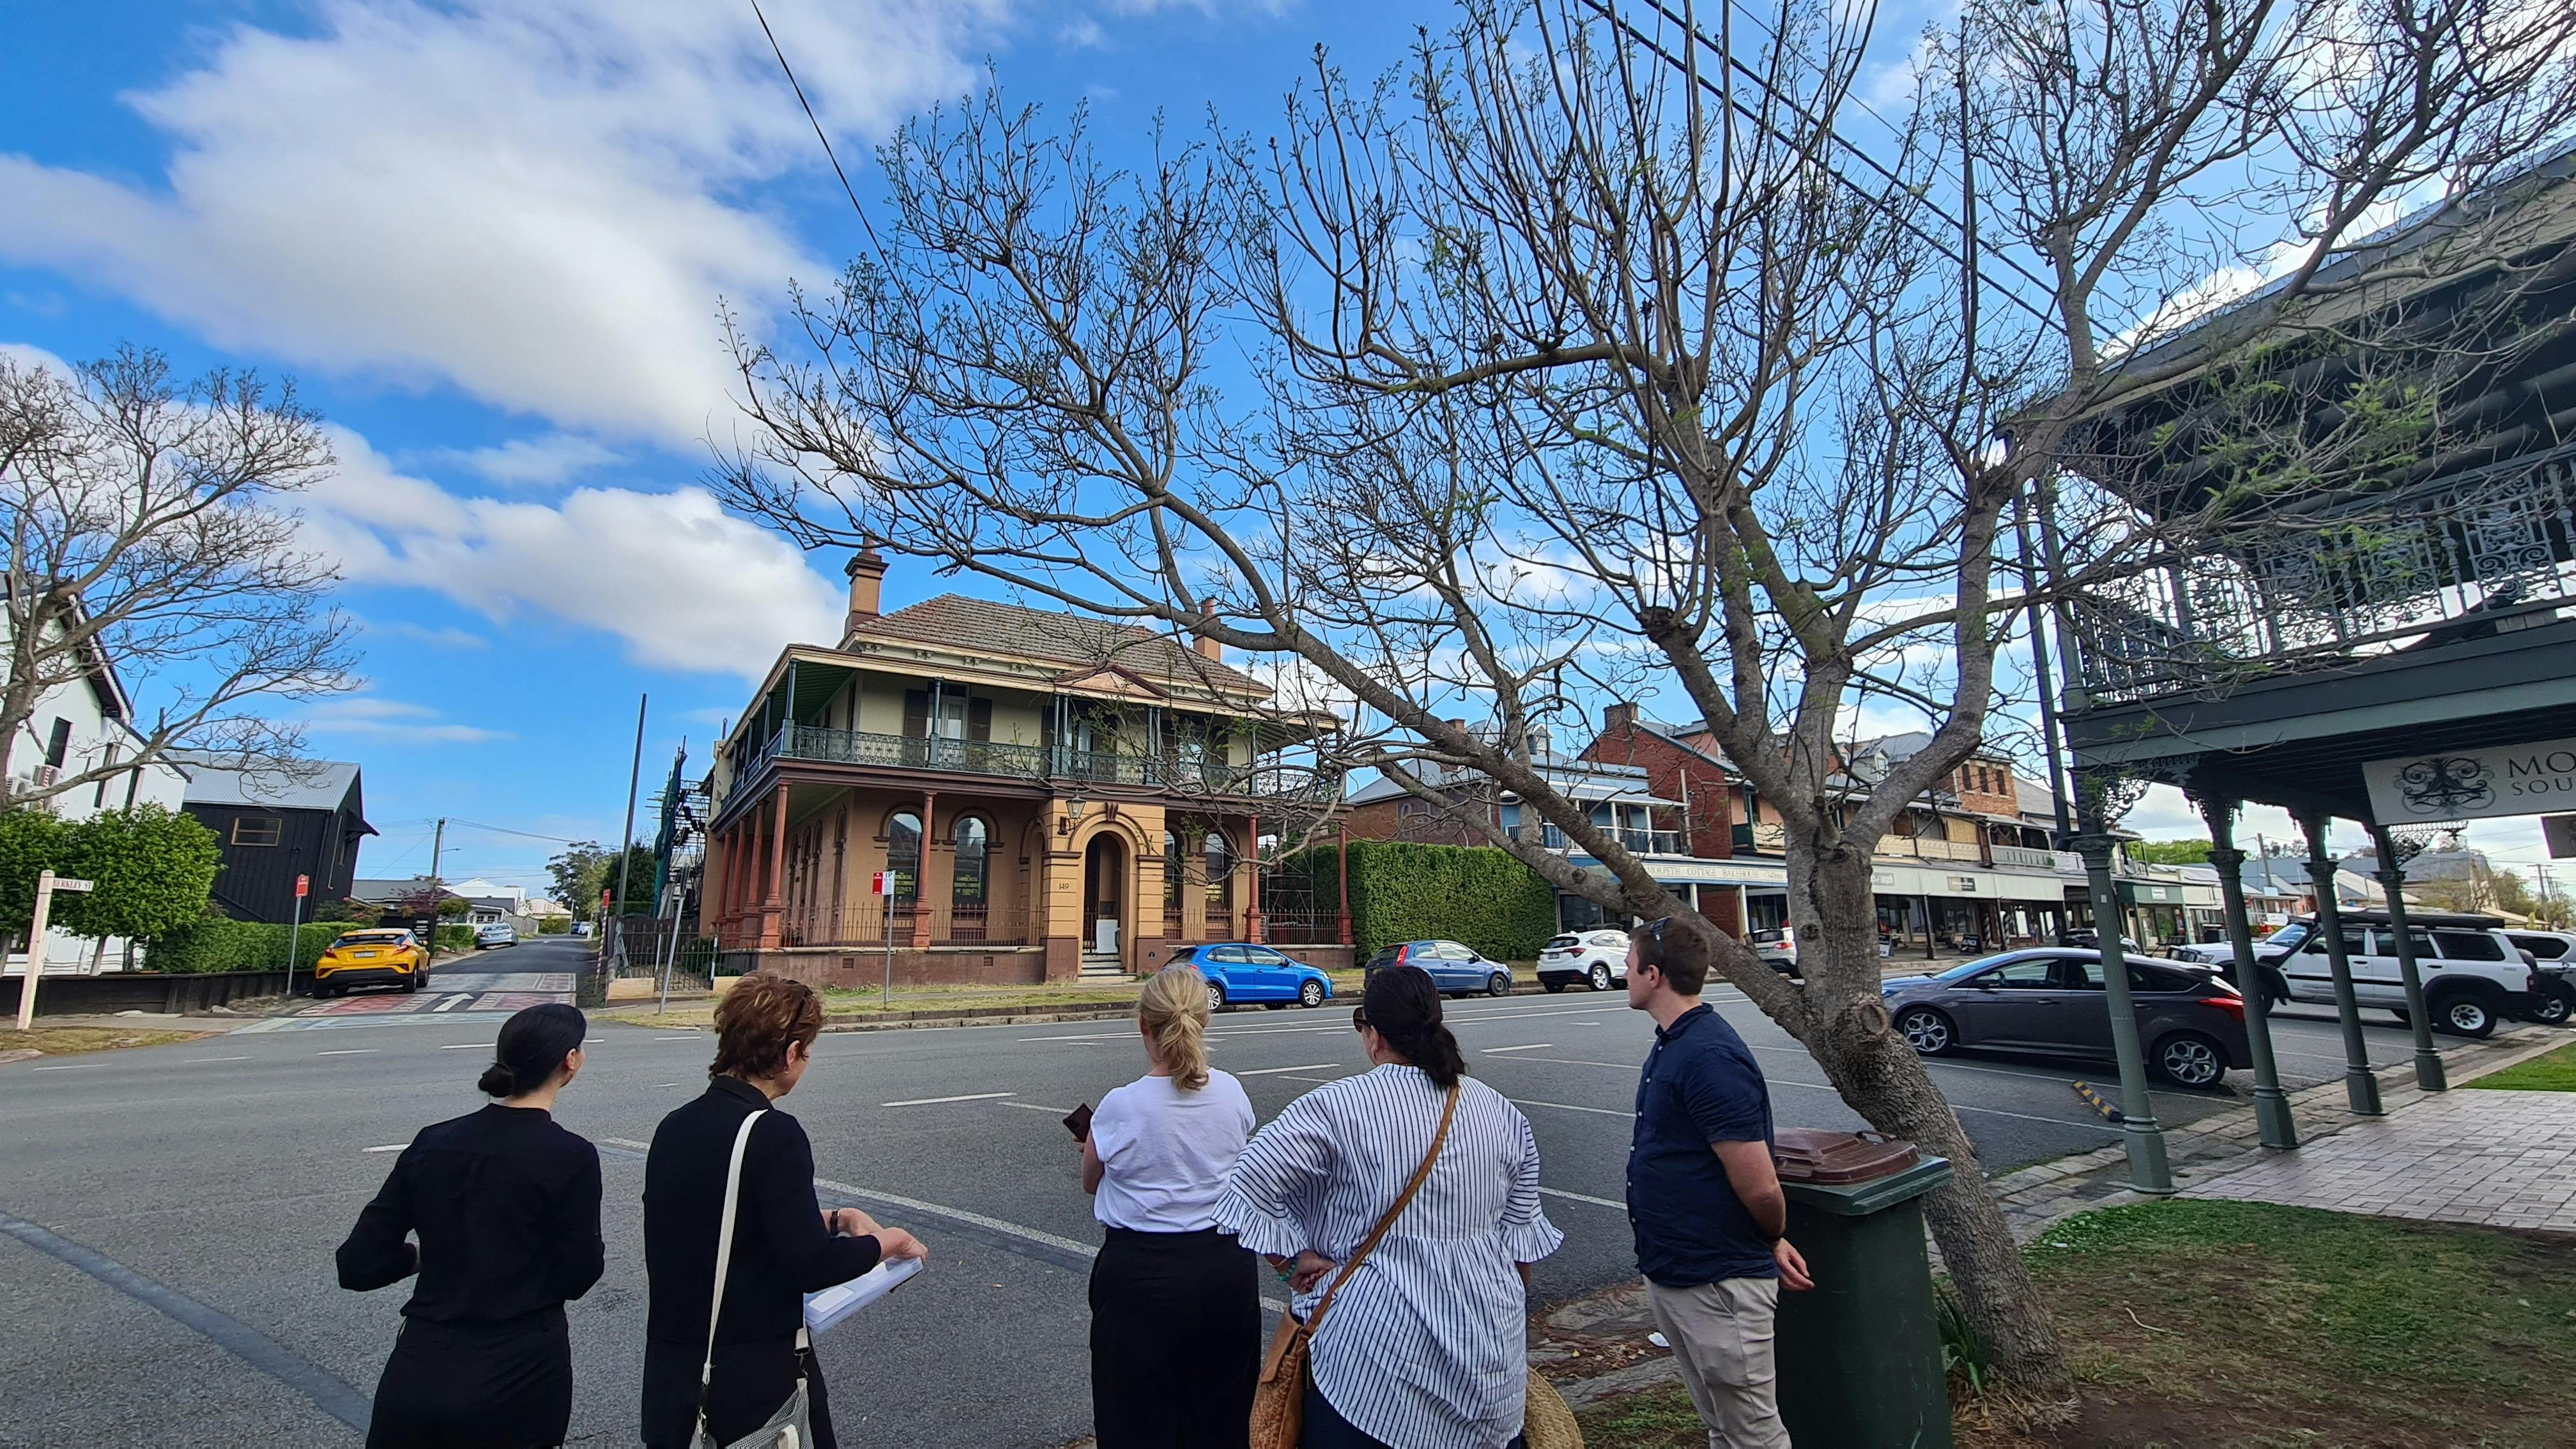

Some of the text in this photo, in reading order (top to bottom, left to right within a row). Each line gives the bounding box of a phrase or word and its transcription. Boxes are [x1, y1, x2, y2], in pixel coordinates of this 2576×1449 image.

[2511, 777, 2573, 796] SOU
[1647, 866, 1680, 875] MORPETH
[1687, 867, 1717, 877] COTTAGE
[1722, 869, 1759, 878] BAKEHOUSE
